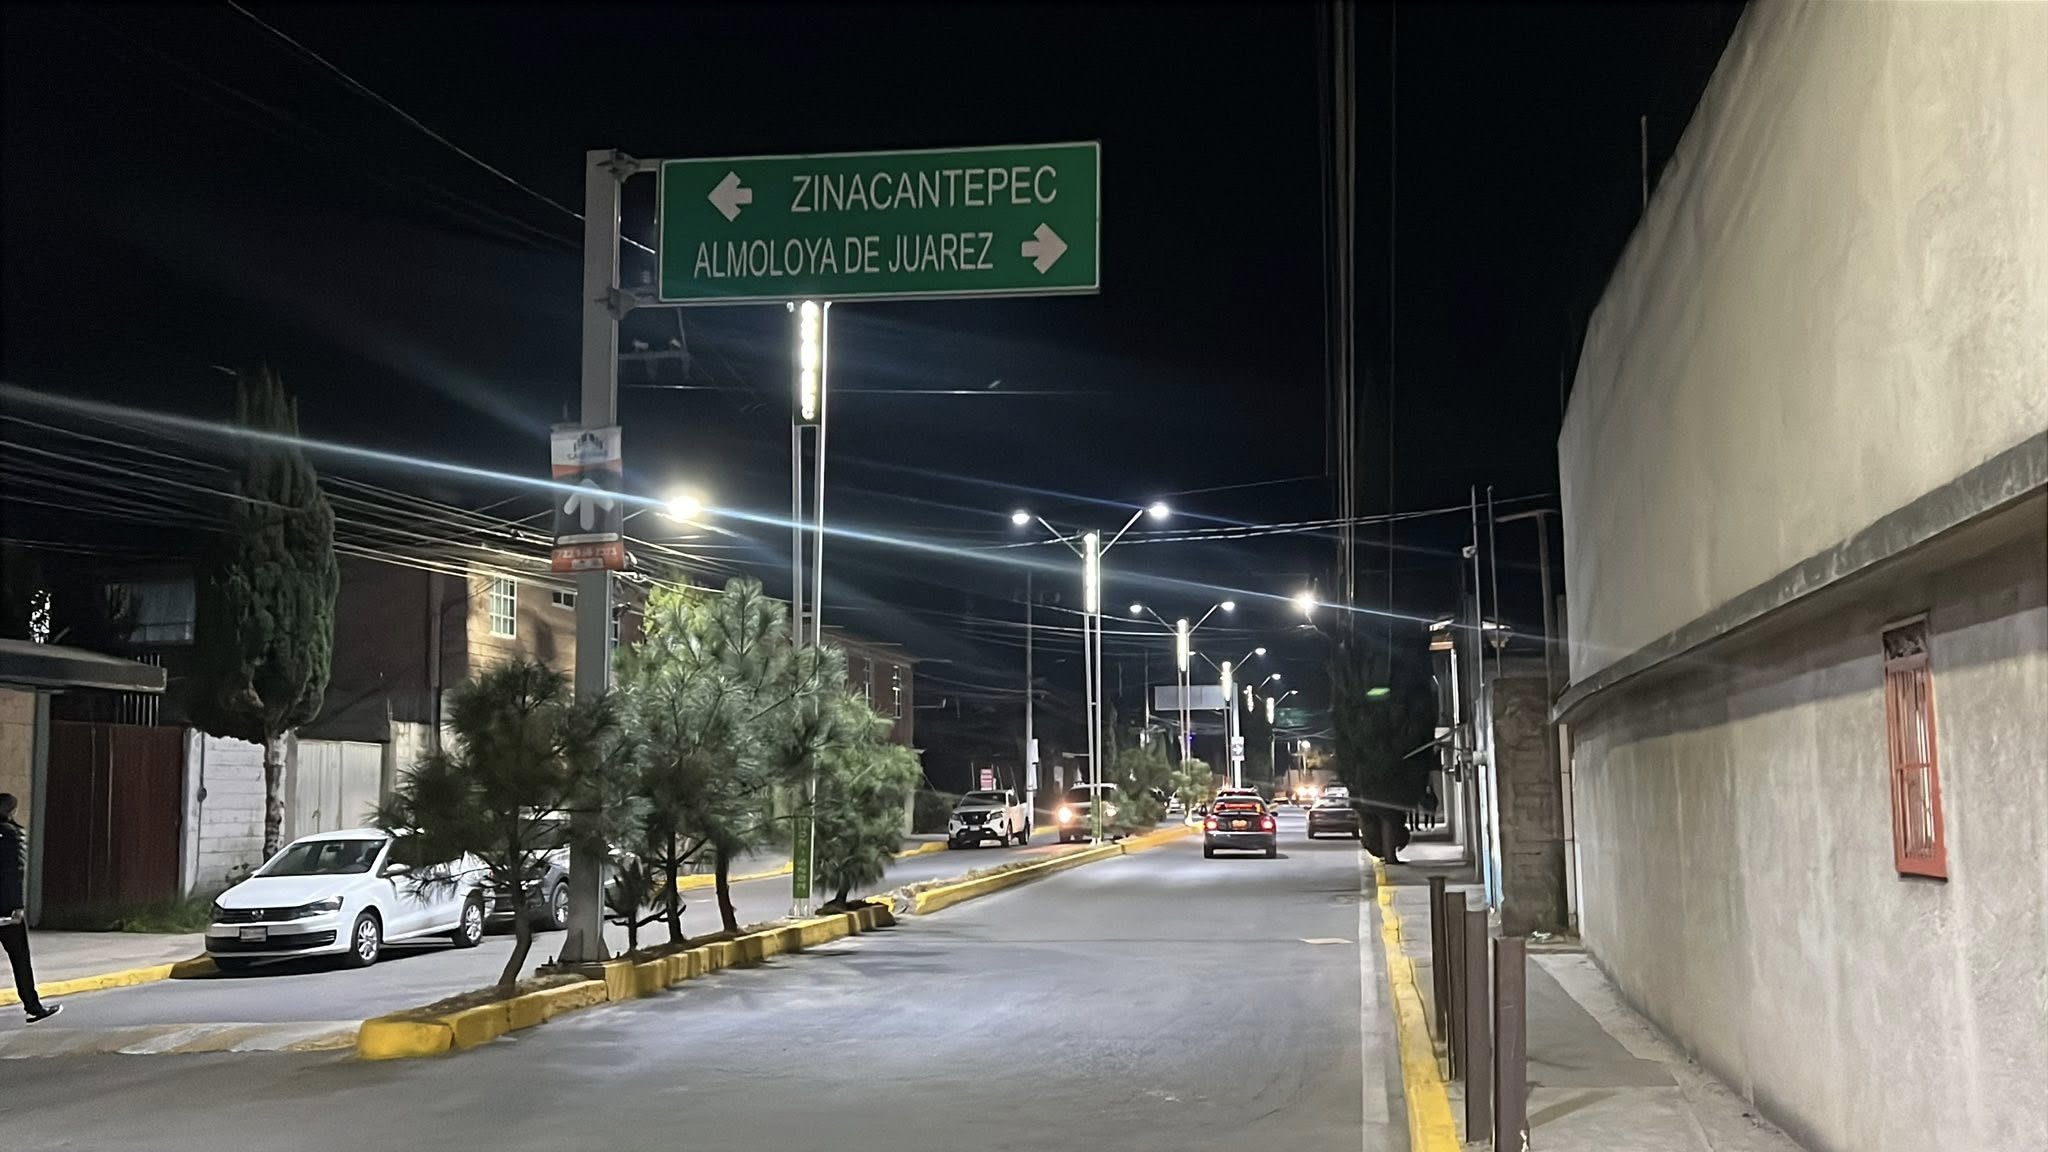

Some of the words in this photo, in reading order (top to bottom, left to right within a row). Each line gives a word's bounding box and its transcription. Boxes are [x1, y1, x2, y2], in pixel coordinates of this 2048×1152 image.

[790, 164, 1058, 213] ZINACANTEPEC
[693, 237, 838, 279] ALMOLOYA
[844, 235, 881, 274] DE
[888, 231, 994, 273] JUAREZ
